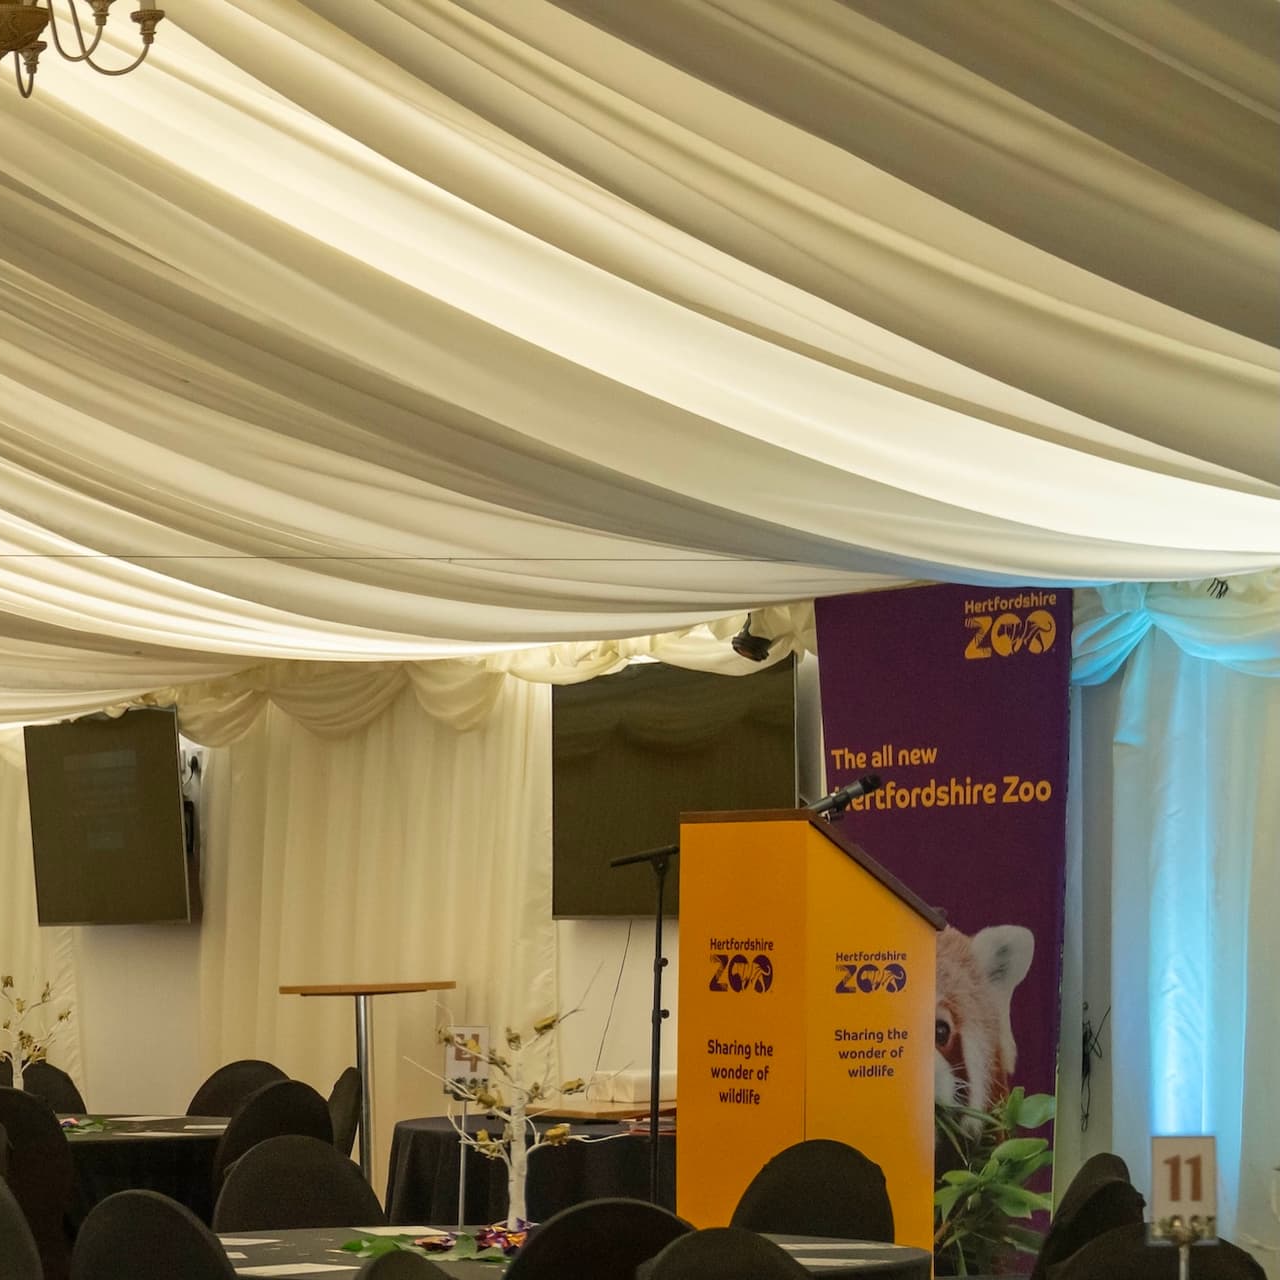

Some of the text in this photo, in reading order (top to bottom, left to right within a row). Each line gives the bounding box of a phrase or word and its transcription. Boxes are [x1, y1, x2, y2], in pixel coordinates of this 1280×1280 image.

[963, 592, 1057, 615] Hertfordshire
[963, 610, 1057, 660] ZOO
[831, 744, 938, 771] The all new
[833, 776, 1053, 812] ertfordshire Zoo
[709, 937, 774, 952] Hertfordshire
[835, 951, 908, 963] Hertfordshire
[708, 953, 774, 994] ZOO
[834, 962, 908, 994] ZOO
[834, 1027, 909, 1044] Sharing the
[454, 1032, 480, 1073] 4
[707, 1039, 774, 1060] Sharing the
[838, 1046, 905, 1060] wonder of
[710, 1063, 770, 1081] wonder of
[847, 1064, 895, 1078] wildlife
[719, 1087, 761, 1105] wildlife
[1162, 1153, 1203, 1202] 11
